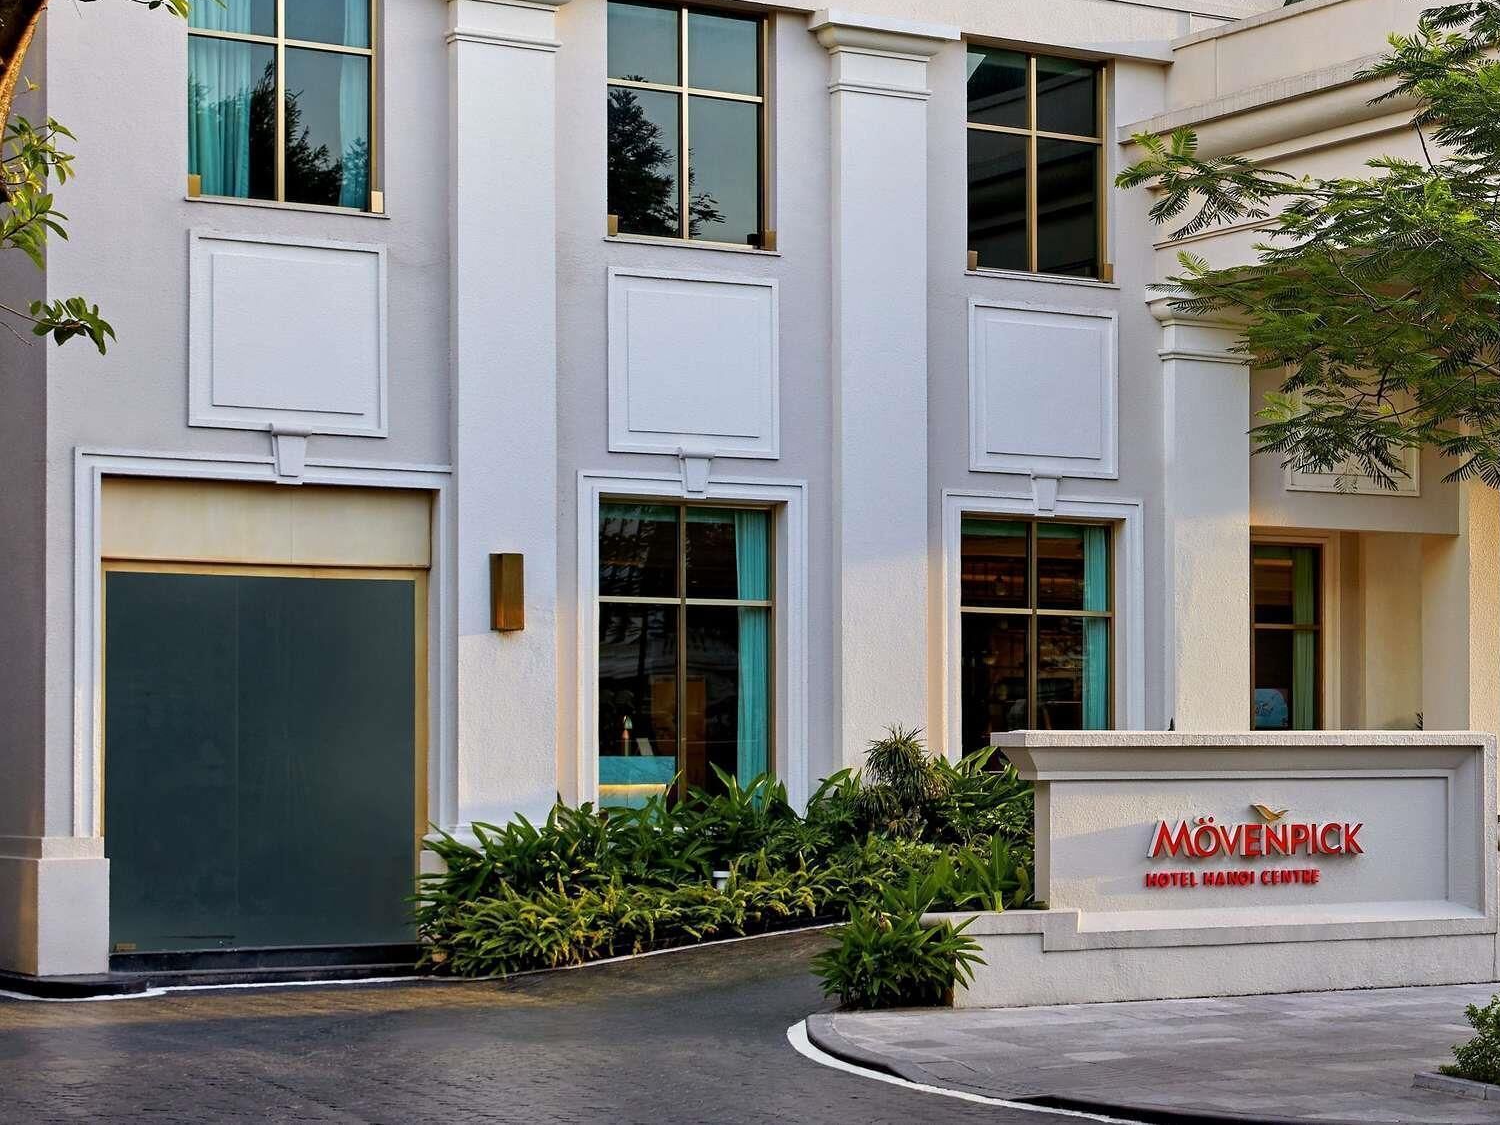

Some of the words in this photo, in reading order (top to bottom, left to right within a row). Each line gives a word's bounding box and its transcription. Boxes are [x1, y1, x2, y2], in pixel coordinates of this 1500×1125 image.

[1147, 815, 1365, 859] MÖVENPICK
[1145, 872, 1198, 888] HOTEL
[1203, 871, 1255, 885] HANOI
[1260, 869, 1321, 885] CENTRE
